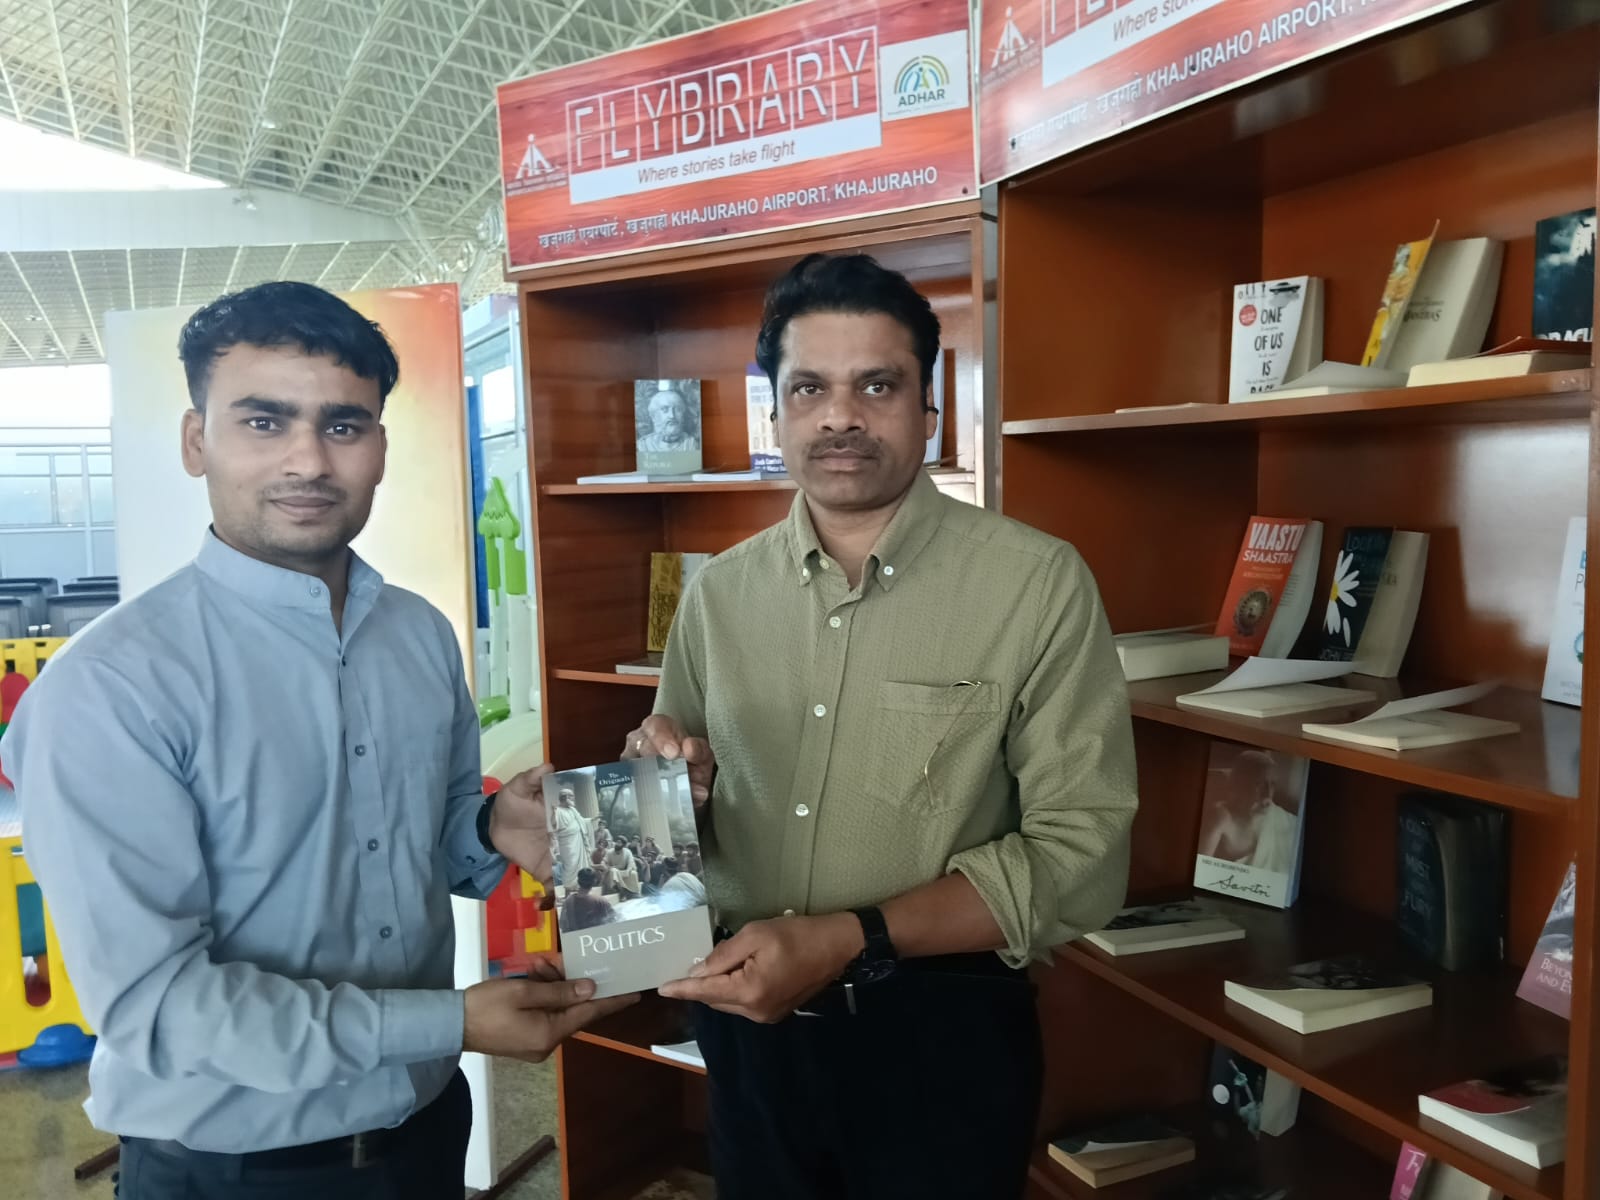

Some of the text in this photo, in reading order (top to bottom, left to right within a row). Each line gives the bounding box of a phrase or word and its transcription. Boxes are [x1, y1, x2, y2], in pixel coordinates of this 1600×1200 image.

[1113, 6, 1158, 41] Where
[1146, 30, 1253, 95] KHAJURAHO
[575, 39, 869, 167] FLYBRARY
[898, 89, 945, 107] ADHAR
[638, 140, 796, 184] Where stories take flight
[671, 166, 937, 227] KHAJURAHO AIRPORT, KHAJURAHO
[1260, 306, 1282, 325] ONE
[1254, 332, 1284, 352] OF US
[1262, 360, 1272, 377] IS
[1248, 522, 1305, 552] VAASTU
[1242, 550, 1297, 565] SHAASTRA
[579, 926, 665, 957] POLITICS
[1541, 957, 1573, 981] BEYON
